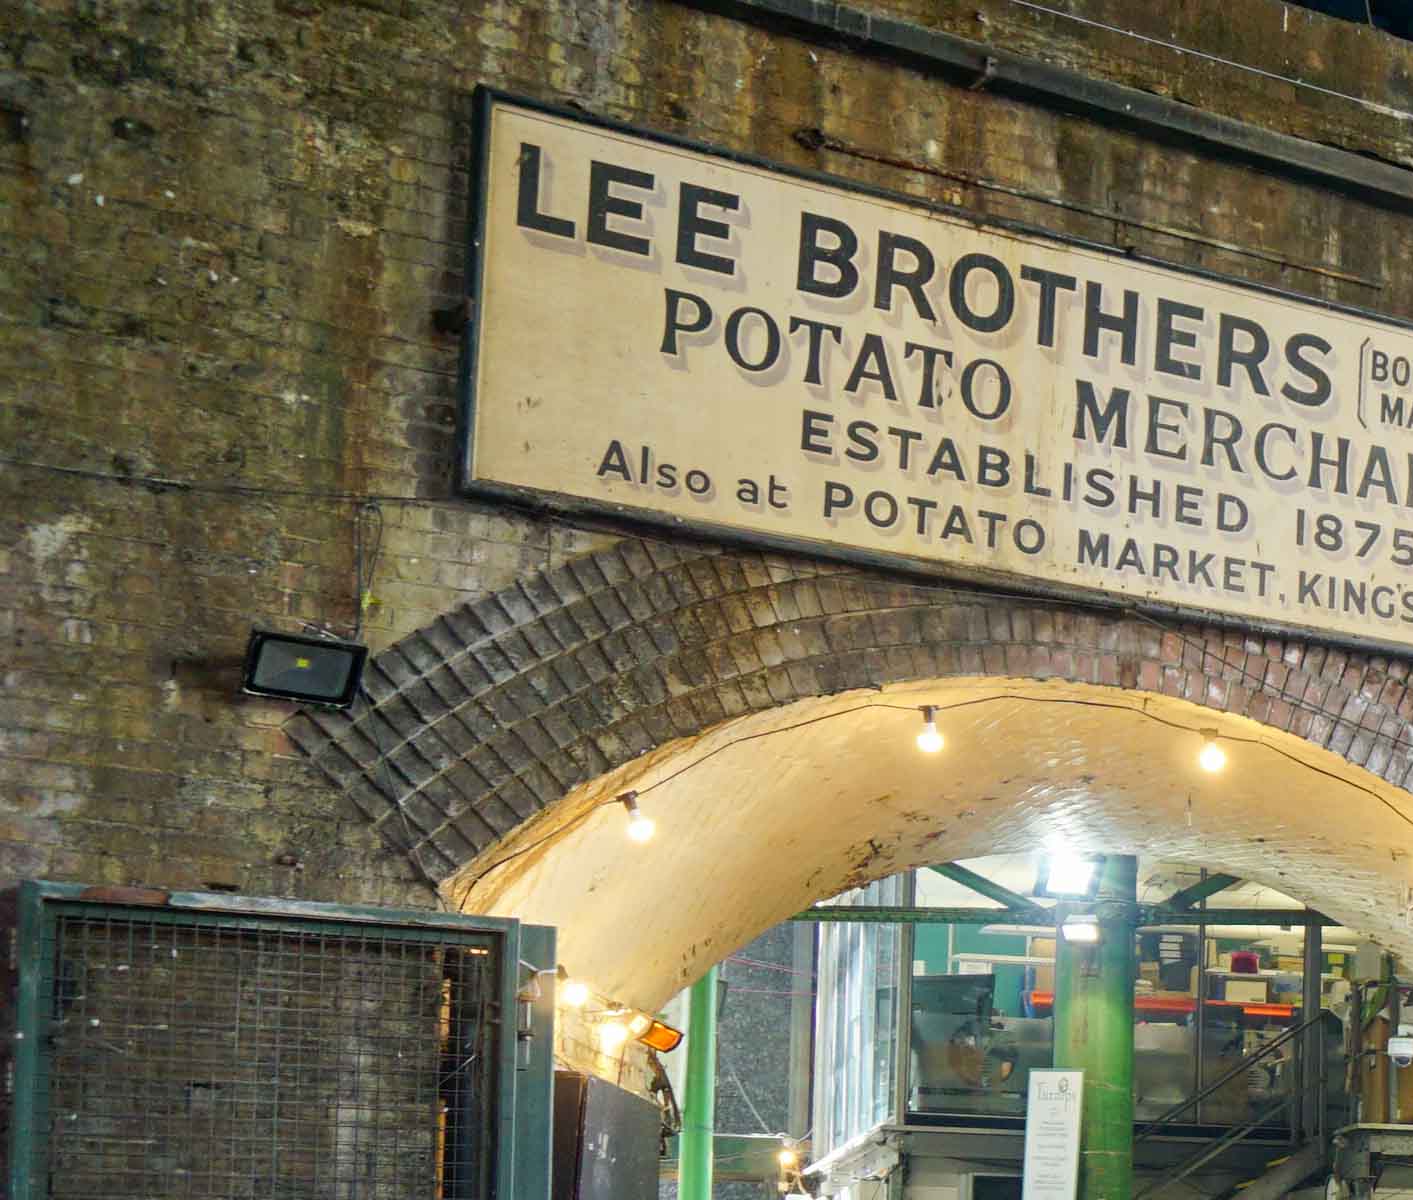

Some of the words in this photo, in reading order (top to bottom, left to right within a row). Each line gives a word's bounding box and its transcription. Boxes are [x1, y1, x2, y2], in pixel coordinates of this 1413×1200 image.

[515, 141, 741, 276] LEE
[796, 211, 1333, 408] BROTHERS
[660, 287, 1013, 421] POTATO
[596, 439, 712, 495] Also
[736, 474, 789, 509] at
[823, 481, 1047, 555] POTATO
[801, 409, 1250, 533] ESTABLISHED
